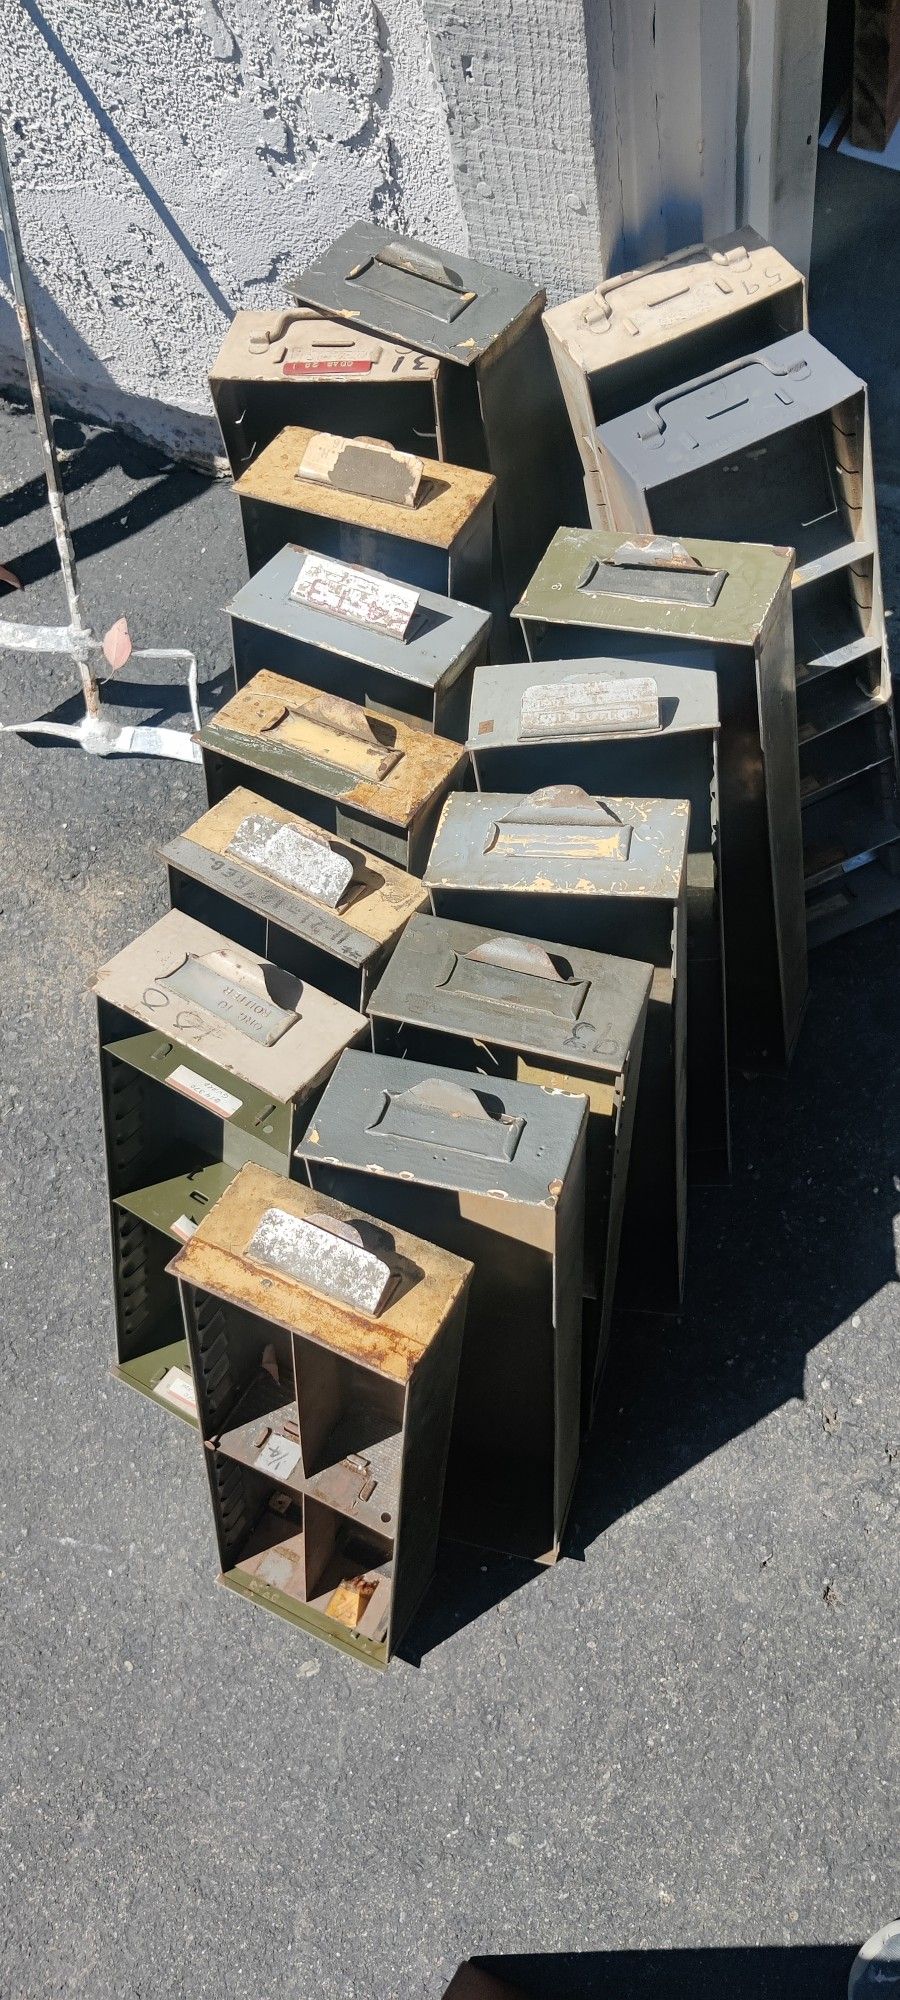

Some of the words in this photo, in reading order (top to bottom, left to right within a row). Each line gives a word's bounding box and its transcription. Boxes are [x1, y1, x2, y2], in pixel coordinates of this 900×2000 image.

[741, 267, 782, 295] 59
[392, 355, 430, 373] 31
[223, 986, 272, 1018] ROUTER
[268, 1445, 290, 1471] 1/4
